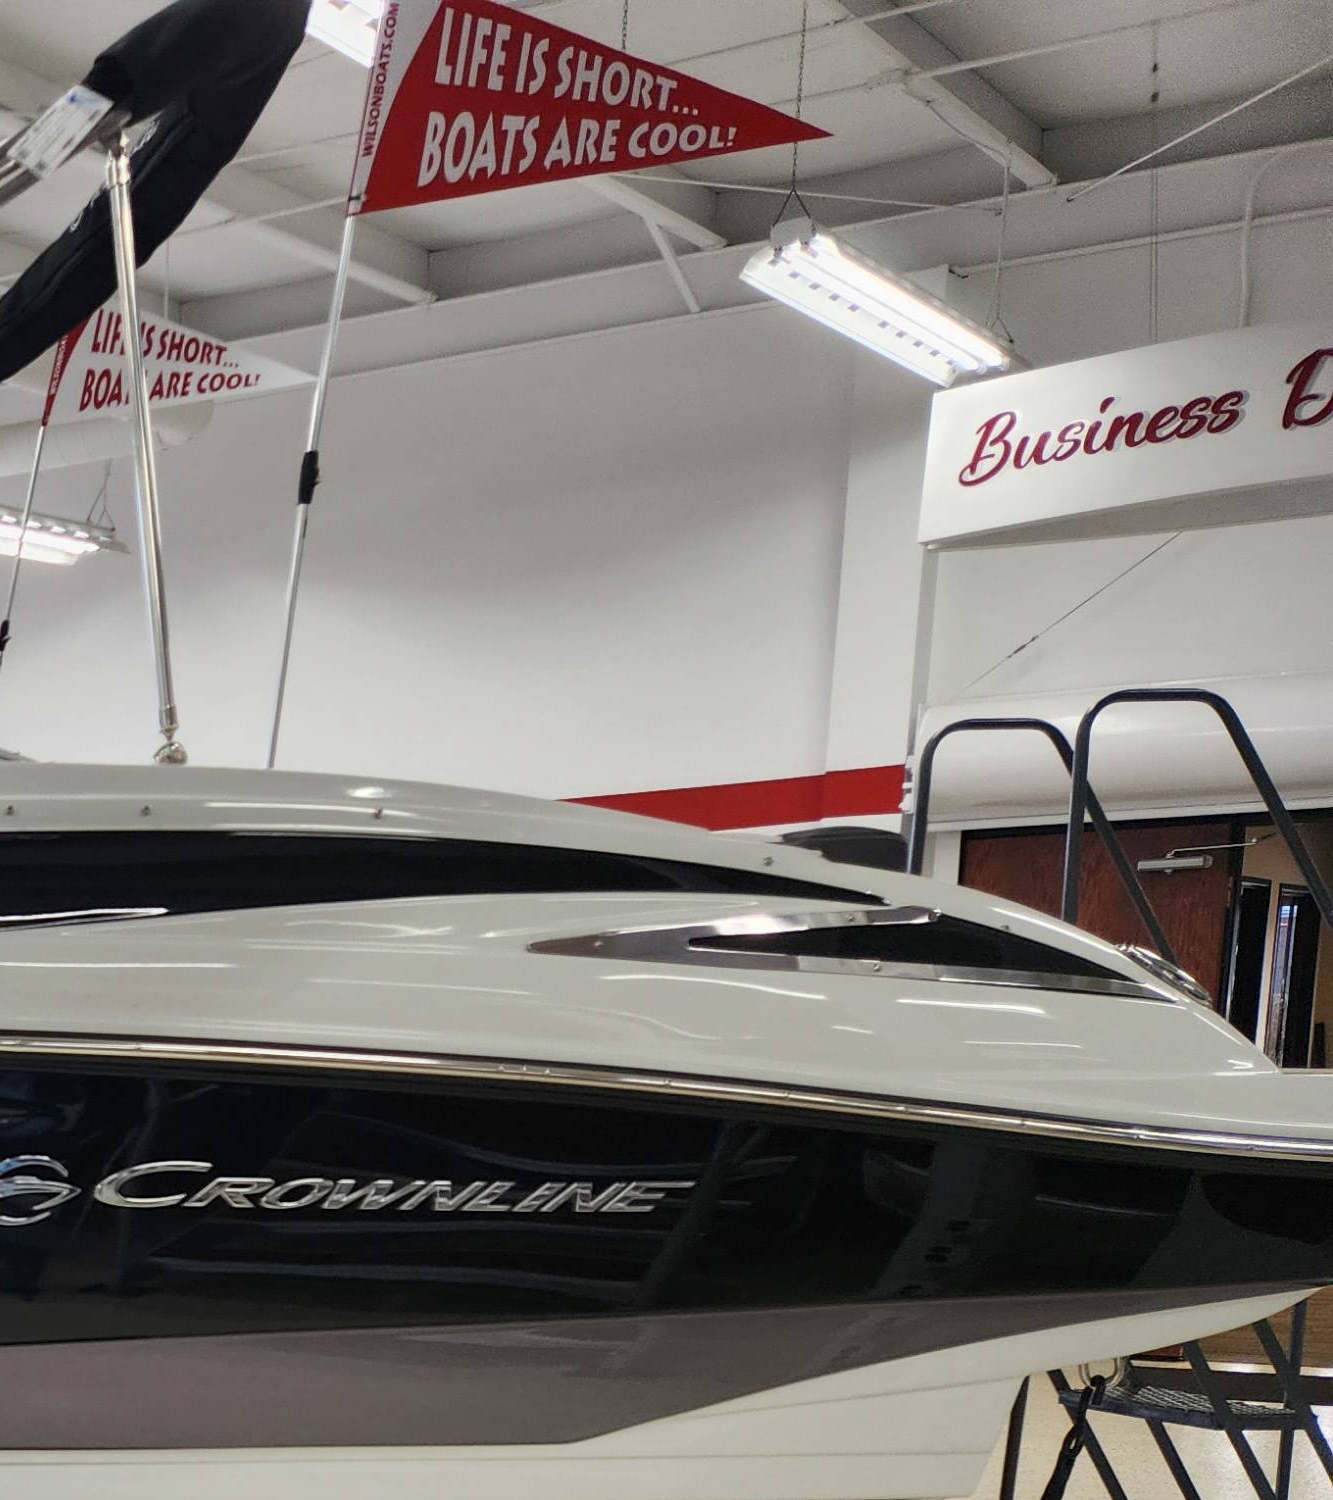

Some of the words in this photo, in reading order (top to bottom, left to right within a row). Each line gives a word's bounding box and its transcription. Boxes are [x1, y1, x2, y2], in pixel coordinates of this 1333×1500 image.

[361, 2, 399, 158] WILSONBOATS.COM
[434, 6, 510, 92] LIFE
[515, 32, 550, 96] IS
[554, 45, 700, 116] SHORT...
[417, 110, 540, 188] BOATS
[543, 118, 621, 171] ARE
[626, 122, 738, 159] COOL!
[91, 308, 126, 356] LIF
[149, 370, 193, 401] ARE
[196, 373, 261, 394] COOL!
[958, 389, 1246, 488] Business
[93, 1160, 697, 1213] CROWNLINE
